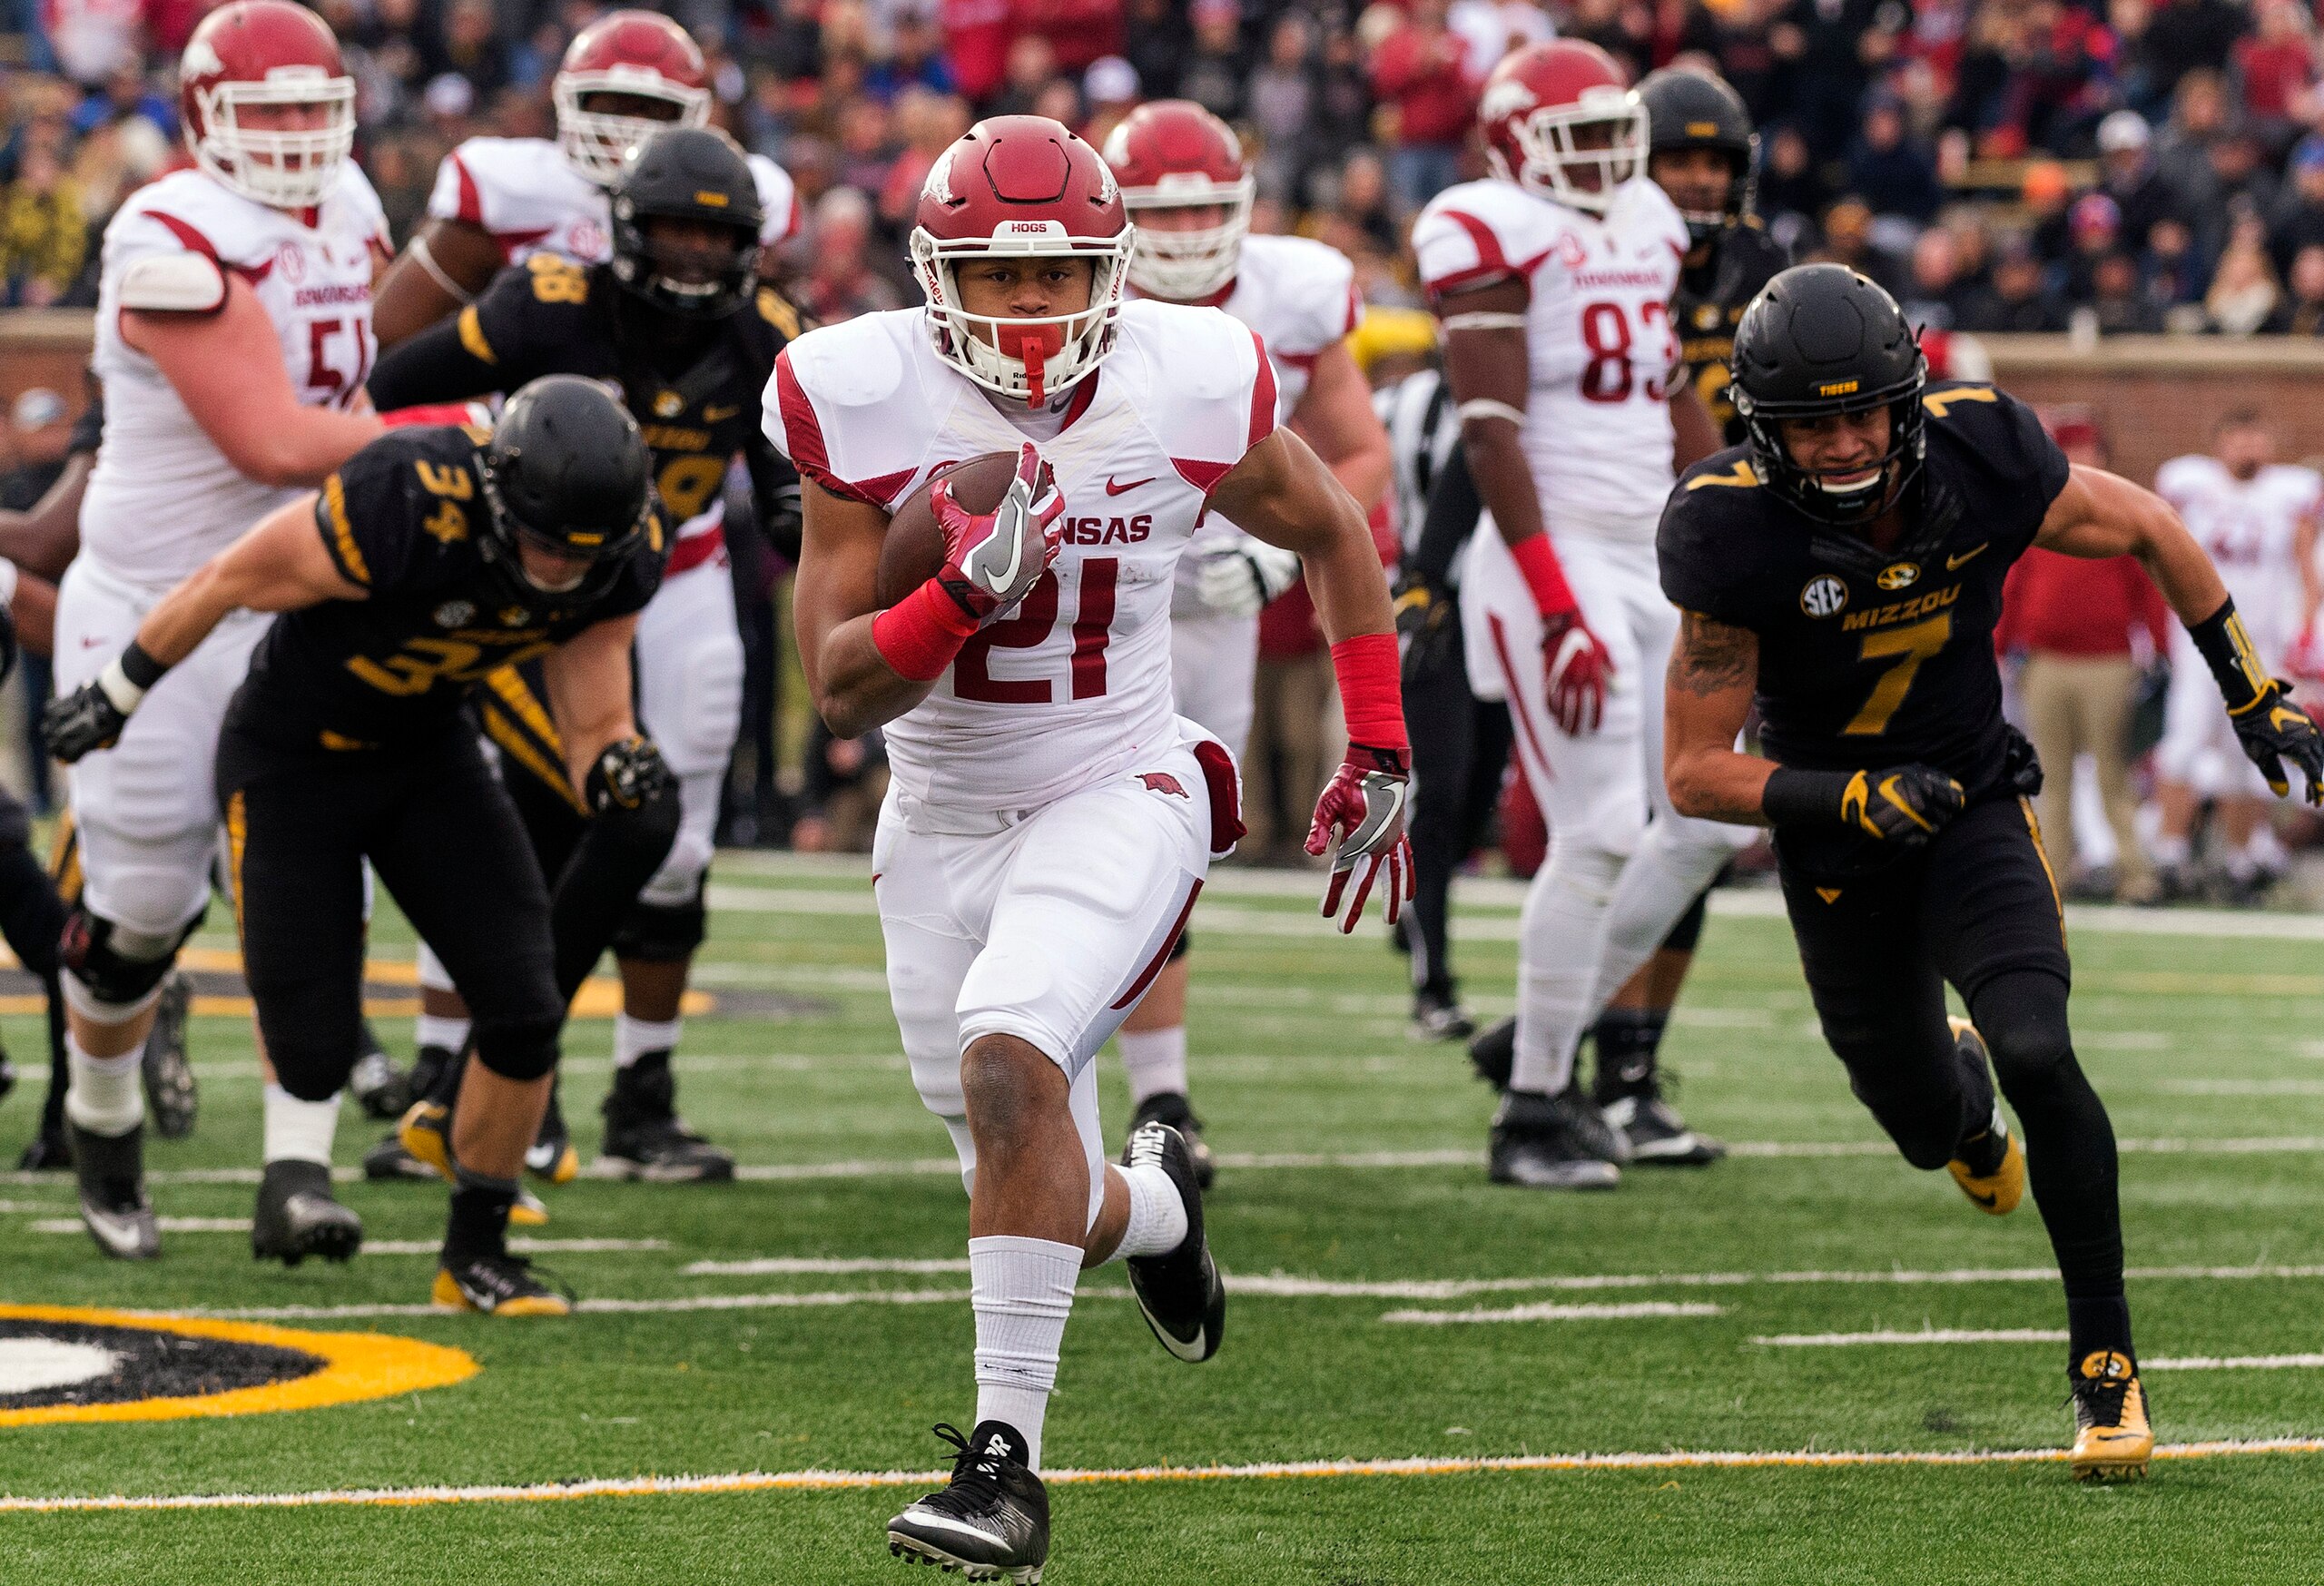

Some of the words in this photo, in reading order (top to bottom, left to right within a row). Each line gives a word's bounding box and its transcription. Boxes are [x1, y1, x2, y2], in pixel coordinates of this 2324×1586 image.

[1011, 223, 1047, 232] HOGS
[308, 320, 367, 408] 51
[1819, 379, 1859, 398] TIGERS
[415, 459, 473, 543] 34
[953, 557, 1119, 704] 21
[1802, 577, 1844, 617] SEC
[1842, 582, 1962, 632] MIZZOU
[1844, 612, 1951, 735] 7
